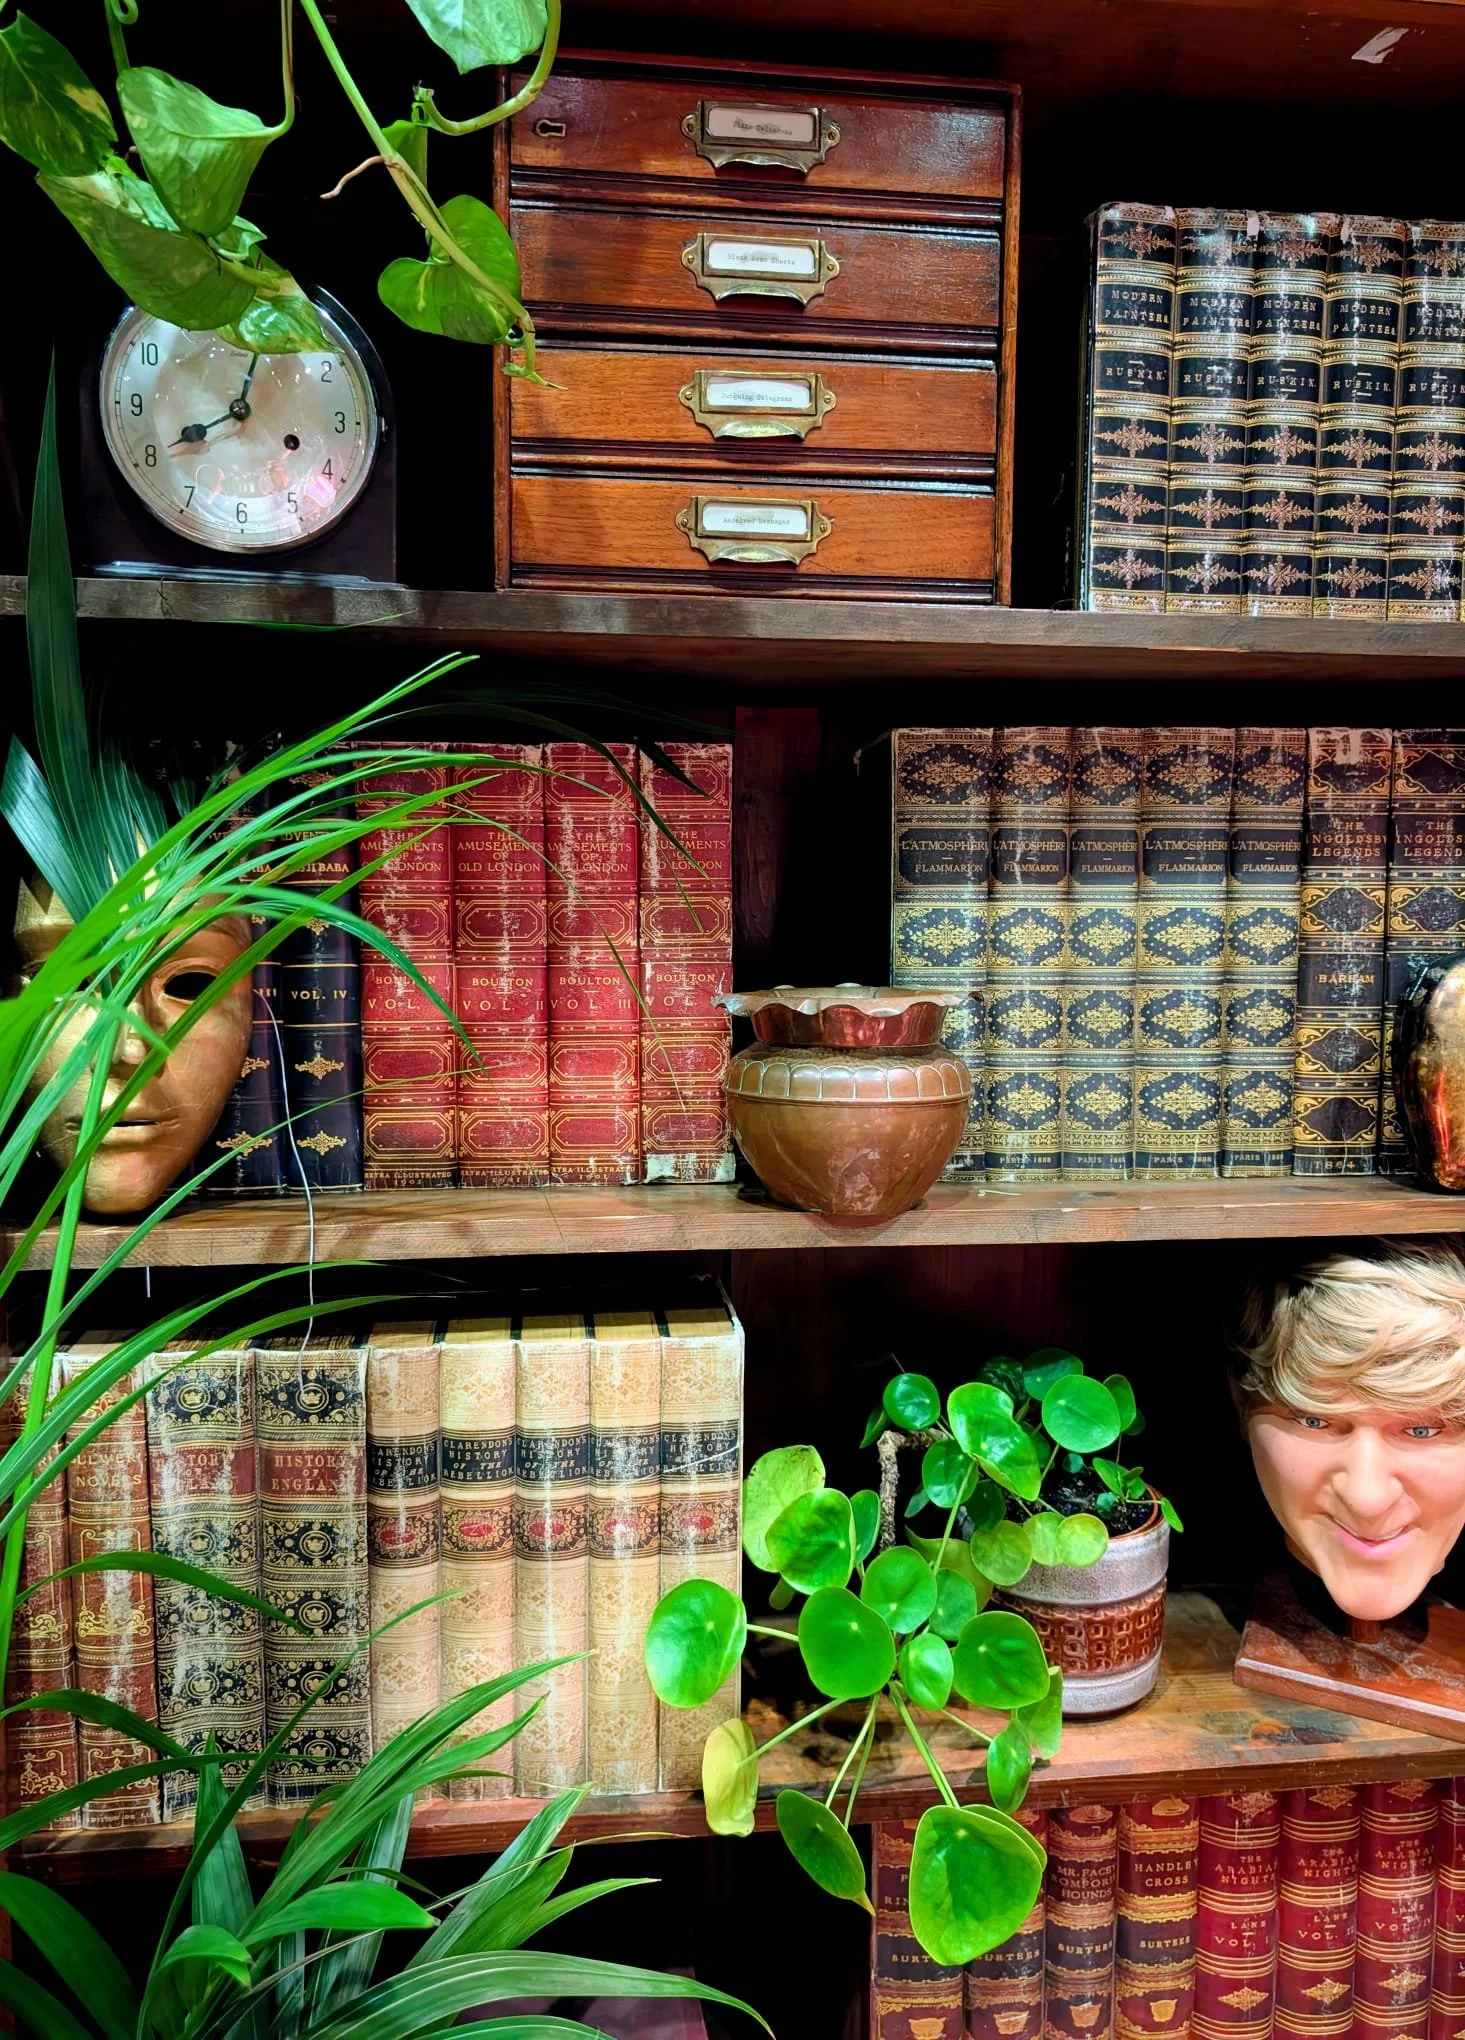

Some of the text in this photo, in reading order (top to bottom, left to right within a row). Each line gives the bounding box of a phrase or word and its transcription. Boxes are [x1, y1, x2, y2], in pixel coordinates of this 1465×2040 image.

[1111, 290, 1164, 304] MODERN
[1339, 304, 1392, 317] MODERN
[141, 342, 159, 366] 10
[320, 361, 332, 383] 2
[130, 394, 143, 416] 9
[334, 411, 346, 434] 3
[145, 444, 157, 467] 8
[321, 458, 333, 480] 4
[184, 486, 195, 508] 7
[287, 492, 298, 514] 5
[236, 502, 247, 523] 6
[1336, 821, 1364, 830] THE
[1426, 822, 1454, 830] THE
[487, 832, 516, 841] THE
[577, 832, 605, 841] THE
[1396, 835, 1465, 844] INGOLDS
[457, 842, 544, 851] AMUSEMENTS
[1232, 838, 1300, 851] L'ATMOSPHÈR
[493, 852, 509, 861] OF
[581, 853, 597, 861] OF
[1312, 848, 1381, 857] LEGENDS
[1404, 848, 1465, 857] LEGEND
[317, 863, 350, 873] BABA
[458, 863, 541, 872] OLD LONDON
[576, 863, 628, 872] LONDON
[915, 864, 983, 873] FLAMMARION
[1082, 864, 1135, 873] FLAMMARION
[1158, 864, 1224, 873] FLAMMARION
[1242, 864, 1298, 873] FLAMMARION
[375, 976, 437, 985] BOULN
[471, 977, 533, 986] BOULTON
[559, 977, 621, 985] BOULTON
[656, 974, 715, 982] BOULTON
[1318, 974, 1375, 984] BARHAM
[291, 990, 347, 1000] VOL. IV
[368, 999, 420, 1009] VOL.
[462, 1001, 544, 1010] VOL. II
[618, 999, 631, 1009] III
[449, 1449, 507, 1460] HISTORY
[274, 1455, 349, 1468] HISTORY
[453, 1461, 502, 1470] OF THE
[302, 1469, 319, 1477] OF
[444, 1467, 513, 1480] REBELLION
[272, 1478, 352, 1491] ENGLAN
[1057, 1865, 1079, 1877] MR.
[1145, 1875, 1189, 1887] CROSS
[1061, 1888, 1112, 1900] HOUNDS
[1314, 1912, 1348, 1923] LANE
[1231, 1920, 1267, 1930] LANE
[1298, 1929, 1338, 1940] VOL.
[1139, 1935, 1190, 1948] SURTEES
[891, 1954, 931, 1963] SURT
